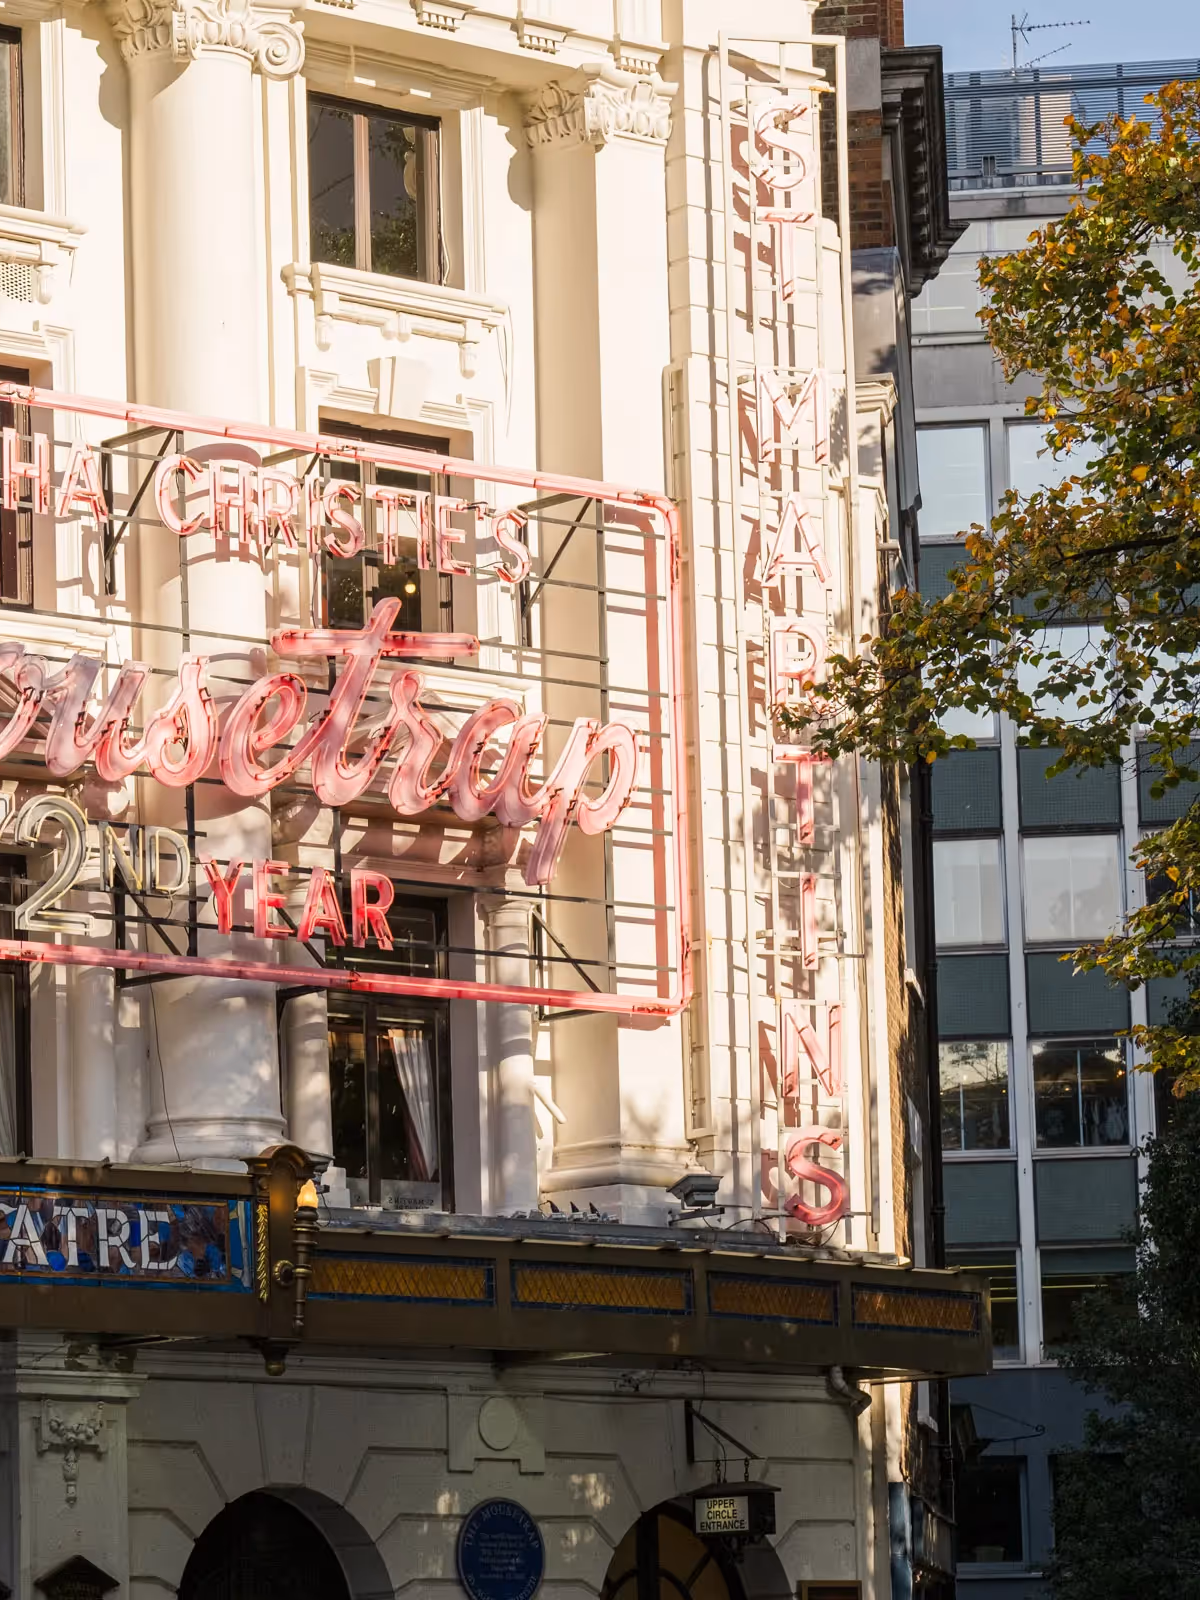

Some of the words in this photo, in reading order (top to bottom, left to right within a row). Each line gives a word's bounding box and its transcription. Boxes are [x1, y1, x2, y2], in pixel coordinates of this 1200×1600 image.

[154, 453, 531, 584] CHRISTIE'S
[203, 855, 396, 950] YEAR
[706, 1499, 735, 1509] UPPER
[706, 1509, 738, 1520] CIRCLE
[699, 1519, 746, 1531] ENTRANCE
